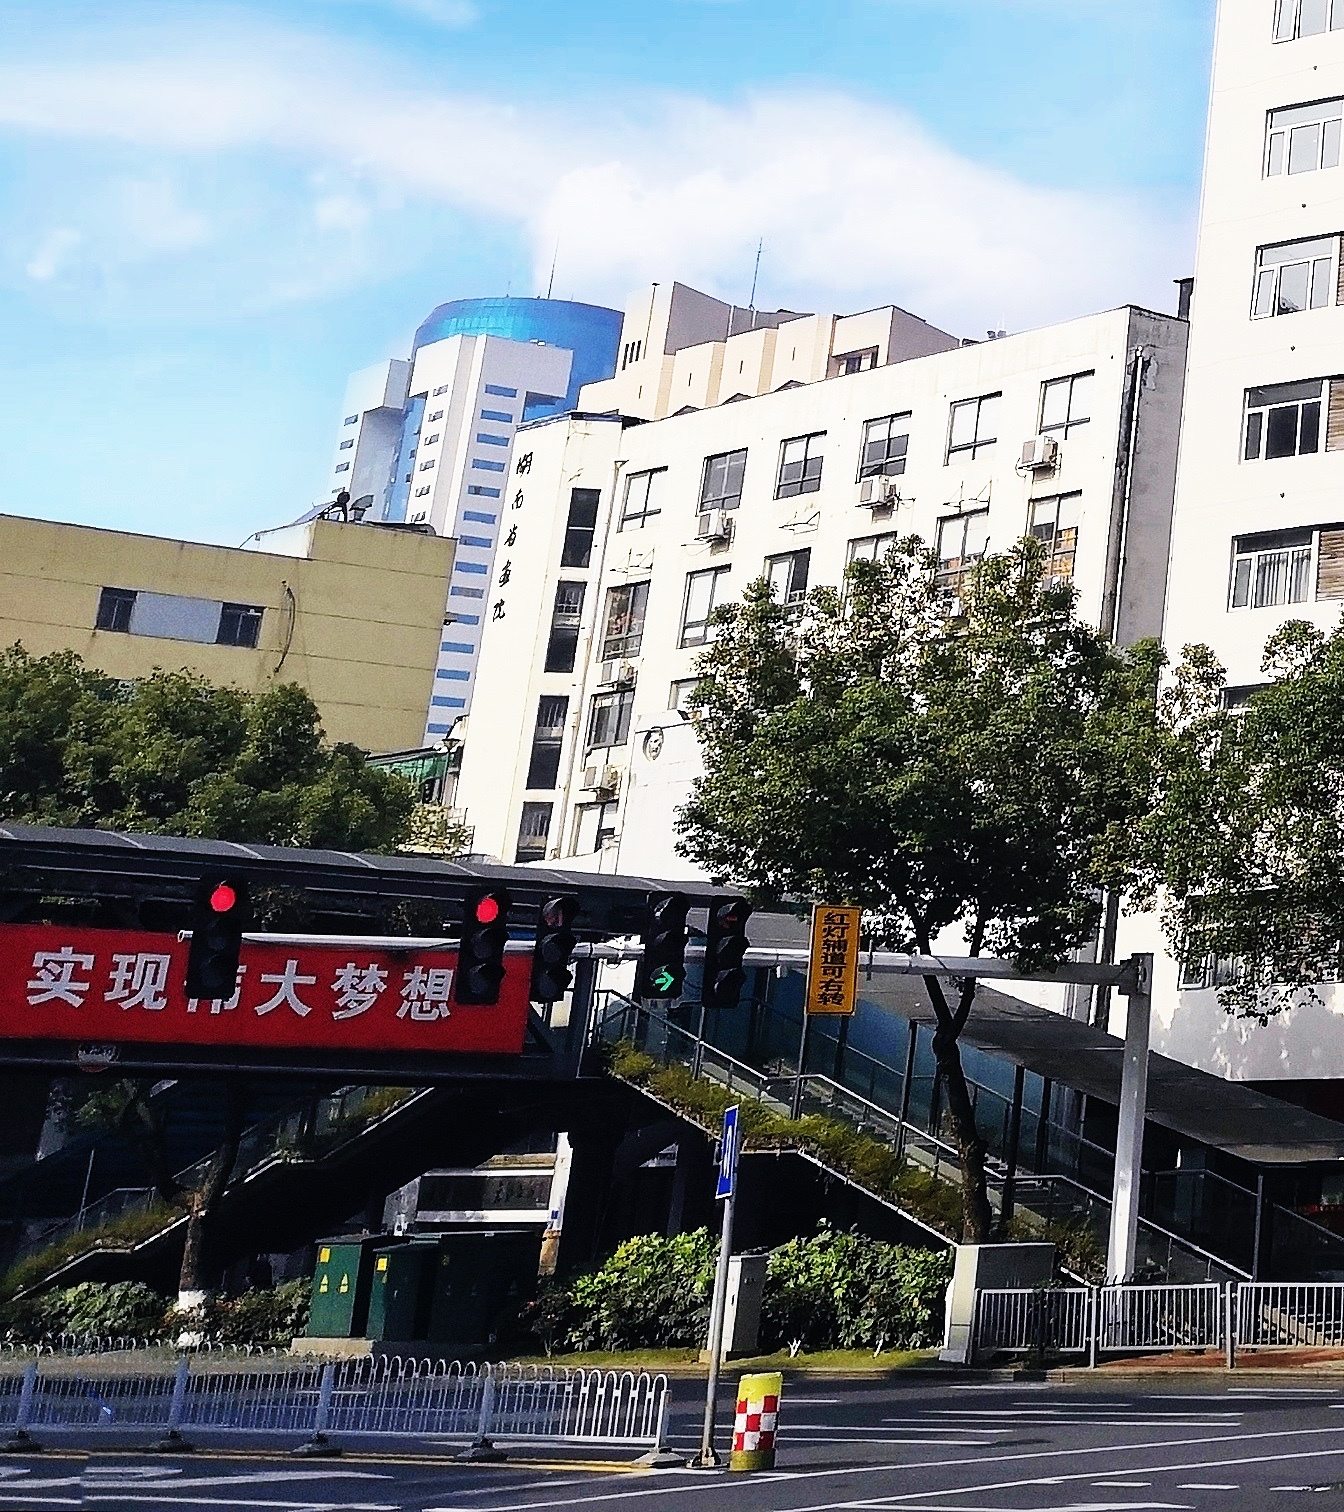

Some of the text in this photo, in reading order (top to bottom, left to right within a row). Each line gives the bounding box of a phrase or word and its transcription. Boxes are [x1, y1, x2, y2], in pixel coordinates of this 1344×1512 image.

[818, 911, 850, 1006] 红灯辅道可右转
